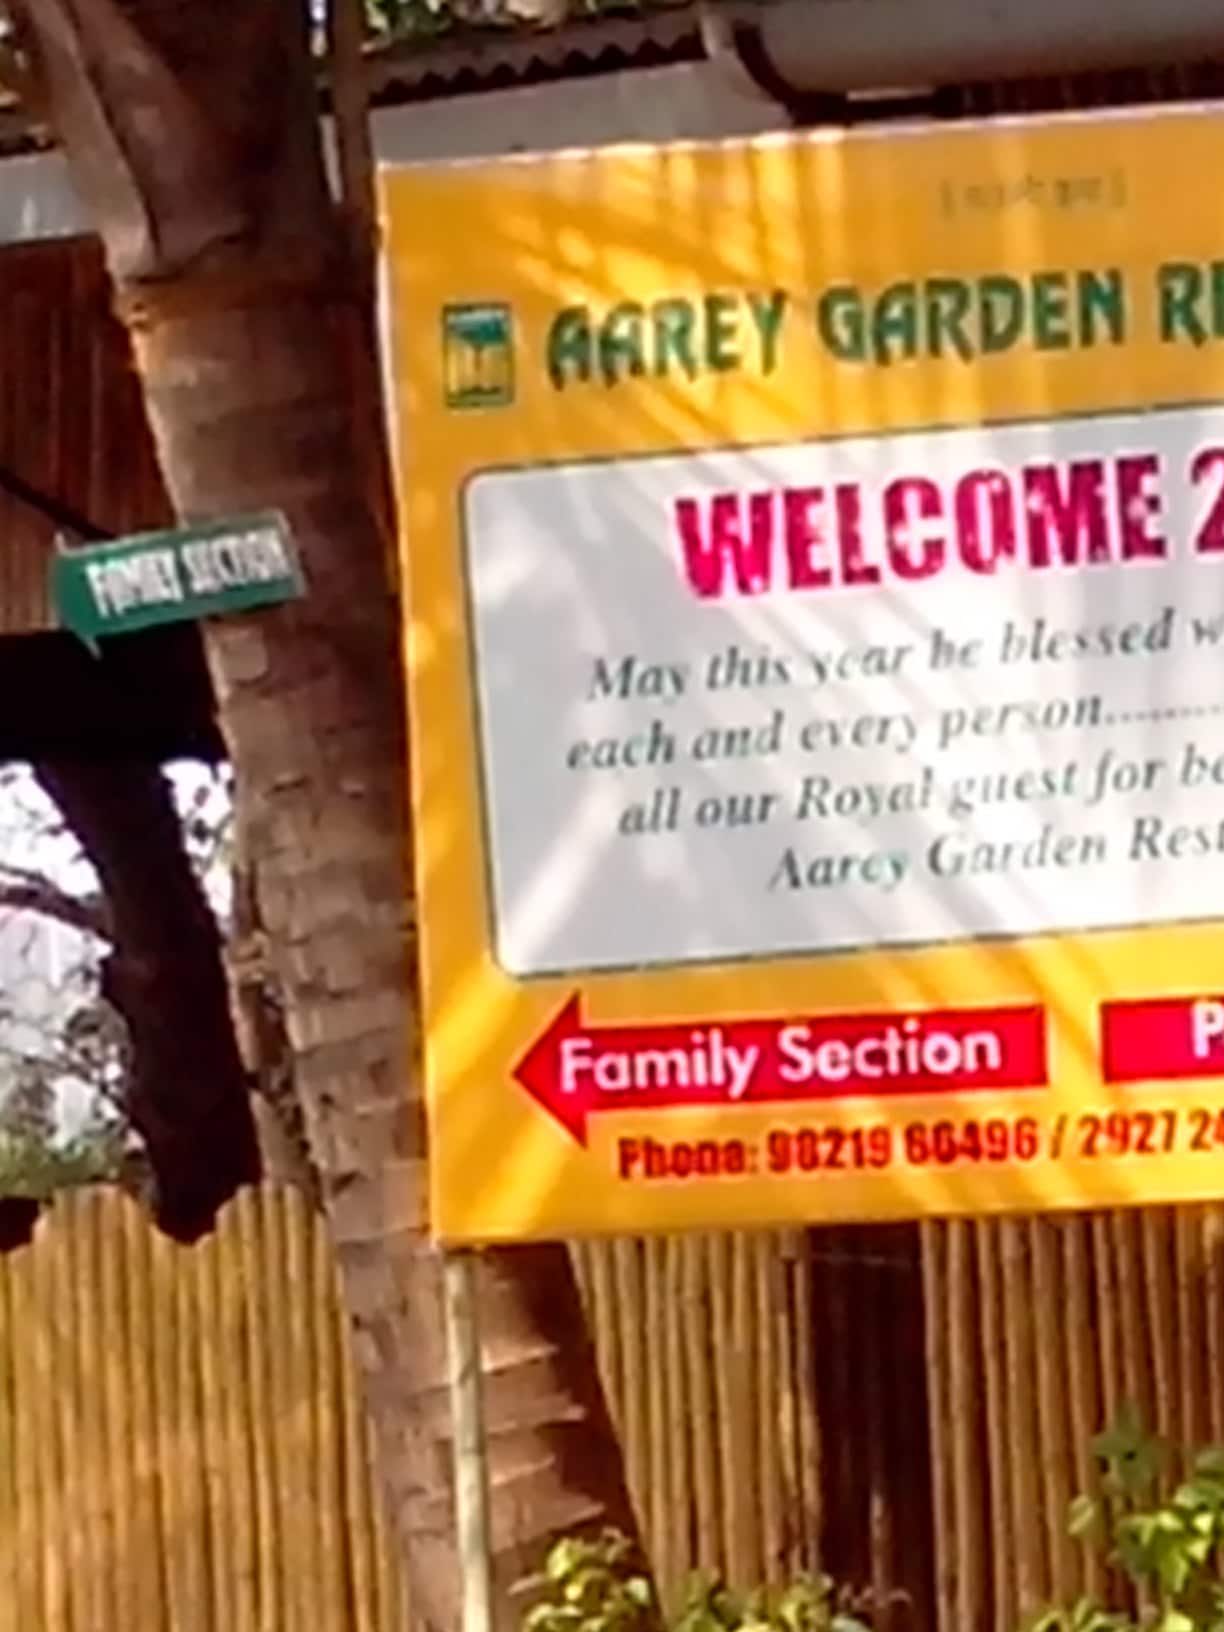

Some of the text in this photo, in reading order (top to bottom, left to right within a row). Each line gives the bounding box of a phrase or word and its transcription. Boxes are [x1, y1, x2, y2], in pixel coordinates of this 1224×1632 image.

[547, 290, 788, 391] AAREY
[816, 268, 1125, 367] GARDEN
[674, 454, 1167, 599] WELCOME
[588, 656, 687, 704] May
[706, 646, 791, 691] this
[807, 645, 912, 687] year
[929, 628, 979, 670] be
[1000, 607, 1174, 666] blessed
[566, 721, 675, 770] each
[692, 710, 783, 761] and
[800, 715, 917, 755] every
[619, 790, 680, 836] all
[695, 792, 776, 828] our
[796, 768, 933, 821] Royal
[947, 762, 1079, 814] guest
[1090, 745, 1163, 806] for
[770, 848, 909, 892] Aarey
[927, 825, 1105, 878] Garden
[560, 1018, 1001, 1099] Family Section
[618, 1136, 760, 1180] Phone:
[1080, 1108, 1178, 1157] 2927
